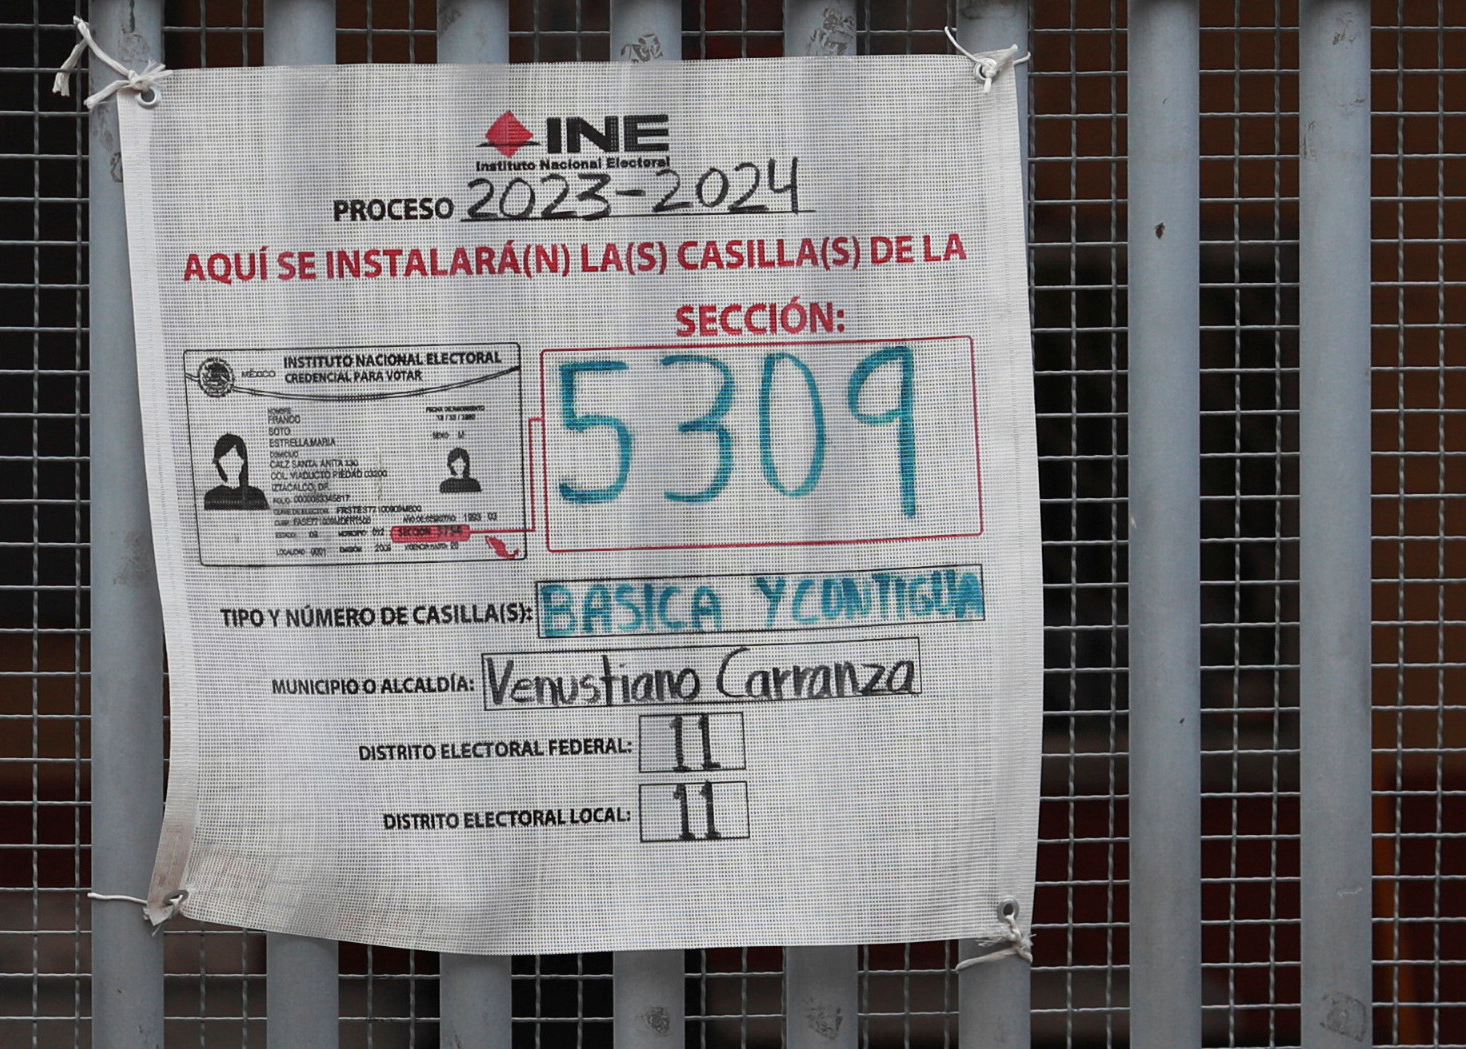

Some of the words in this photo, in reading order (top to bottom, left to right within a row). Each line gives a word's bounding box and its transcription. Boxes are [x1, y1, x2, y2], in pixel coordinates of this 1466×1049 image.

[546, 114, 669, 154] INE
[476, 161, 536, 172] Instituto
[540, 158, 602, 170] Nacional
[606, 156, 670, 169] Electoral
[467, 156, 799, 221] 2023-2024
[334, 198, 455, 221] PROCESO
[183, 245, 269, 285] AQUÍ
[277, 251, 317, 280] SE
[326, 240, 570, 279] INSTALARÁ(N)
[581, 240, 667, 275] LA(S)
[677, 235, 861, 271] CASILLA(S)
[870, 234, 915, 264] DE
[924, 233, 968, 262] LA
[675, 296, 845, 337] SECCIÓN:
[284, 355, 353, 369] INSTITUTO
[355, 353, 423, 368] NACIONAL
[426, 351, 502, 366] ELECTORAL
[284, 372, 352, 384] CREDENCIAL
[354, 371, 384, 383] PARA
[387, 370, 424, 382] VOTAR
[268, 427, 291, 436] SOTO
[558, 345, 916, 517] 5309
[220, 608, 264, 627] TIPO
[266, 609, 280, 627] Y
[286, 605, 376, 627] NÚMERO
[381, 606, 407, 625] DE
[413, 602, 533, 625] CASILLA(S):
[540, 582, 723, 637] BASICA
[271, 679, 359, 695] MUNICIPIO
[362, 678, 376, 695] O
[380, 673, 475, 695] ALCALDÍA:
[485, 655, 700, 706] Venustiano
[717, 647, 916, 698] Carranza
[359, 744, 434, 762] DISTRITO
[441, 740, 544, 760] ELECTORAL
[548, 737, 632, 756] FEDERAL:
[669, 714, 720, 772] 11
[383, 812, 460, 831] DISTRITO
[464, 809, 567, 828] ELECTORAL
[569, 807, 631, 826] LOCAL:
[673, 780, 721, 840] 11
